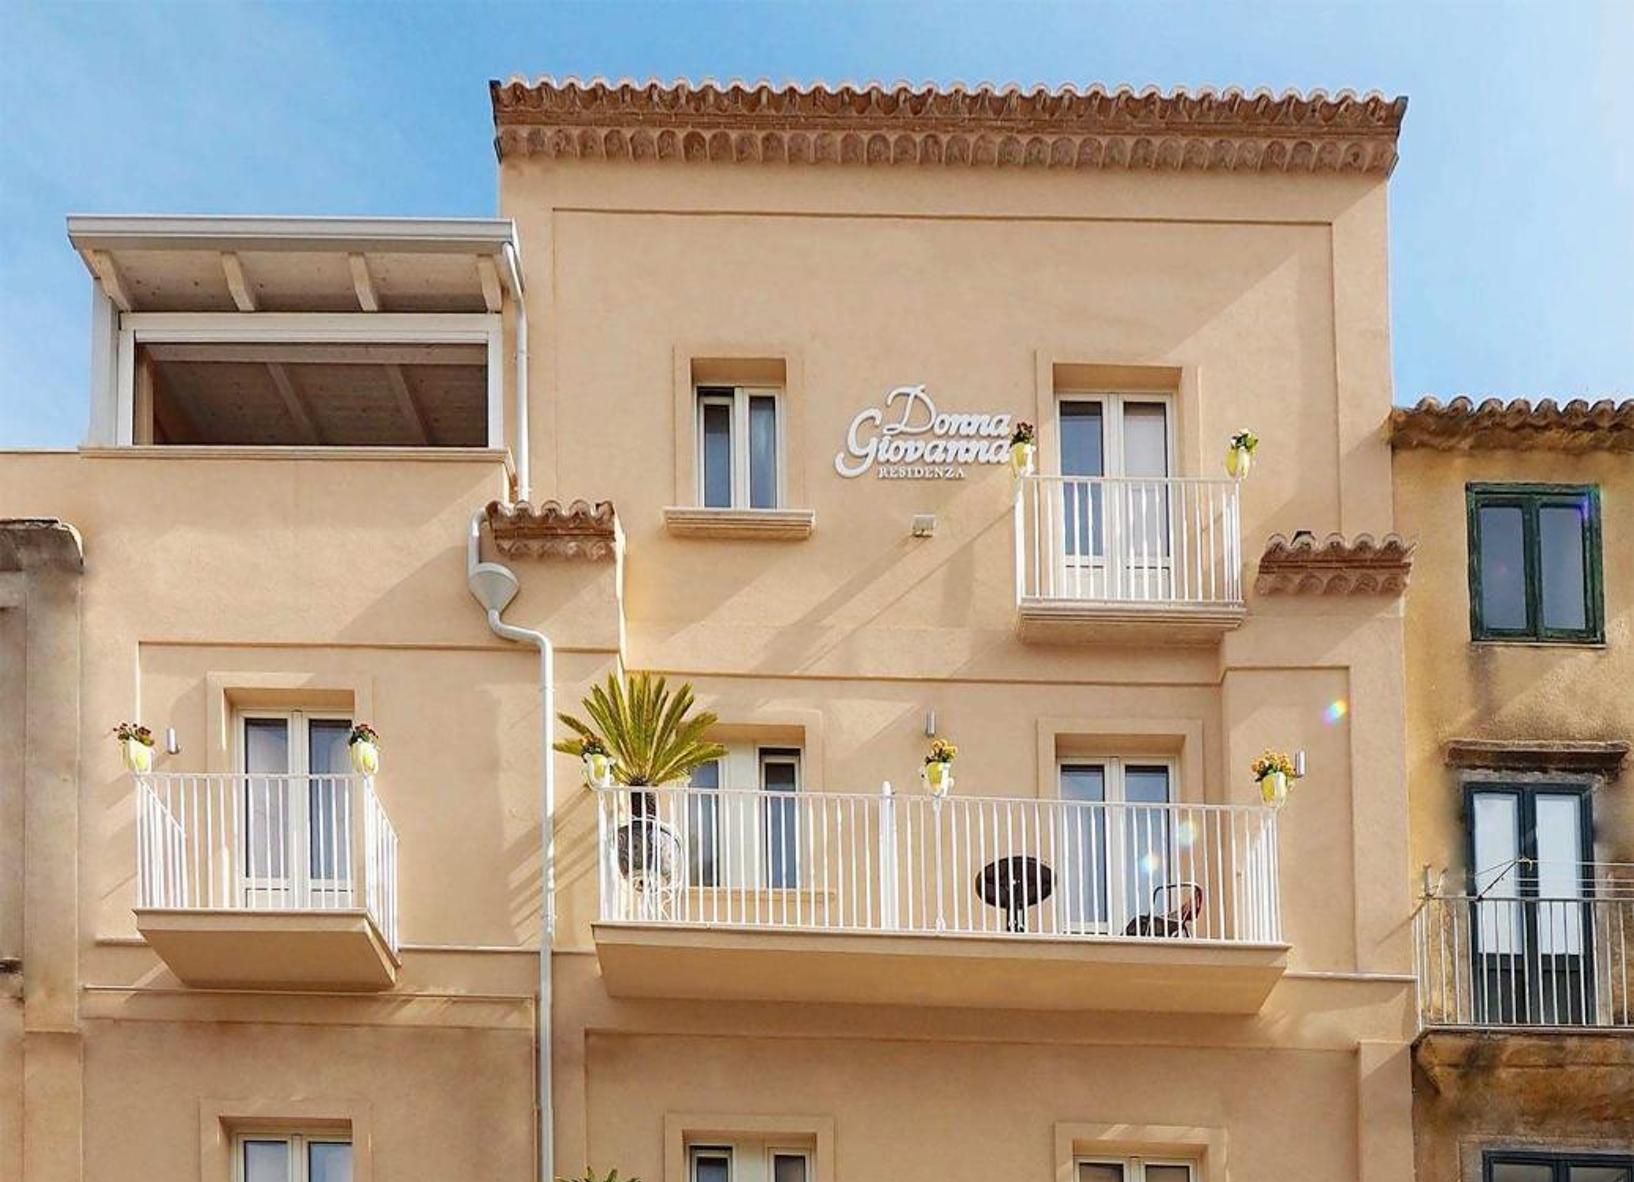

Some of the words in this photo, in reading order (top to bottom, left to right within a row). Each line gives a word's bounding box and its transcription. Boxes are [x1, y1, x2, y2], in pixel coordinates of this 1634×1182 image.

[883, 384, 1012, 438] Donna
[834, 408, 1011, 479] Giovanna
[878, 467, 966, 479] RESIDENZA
